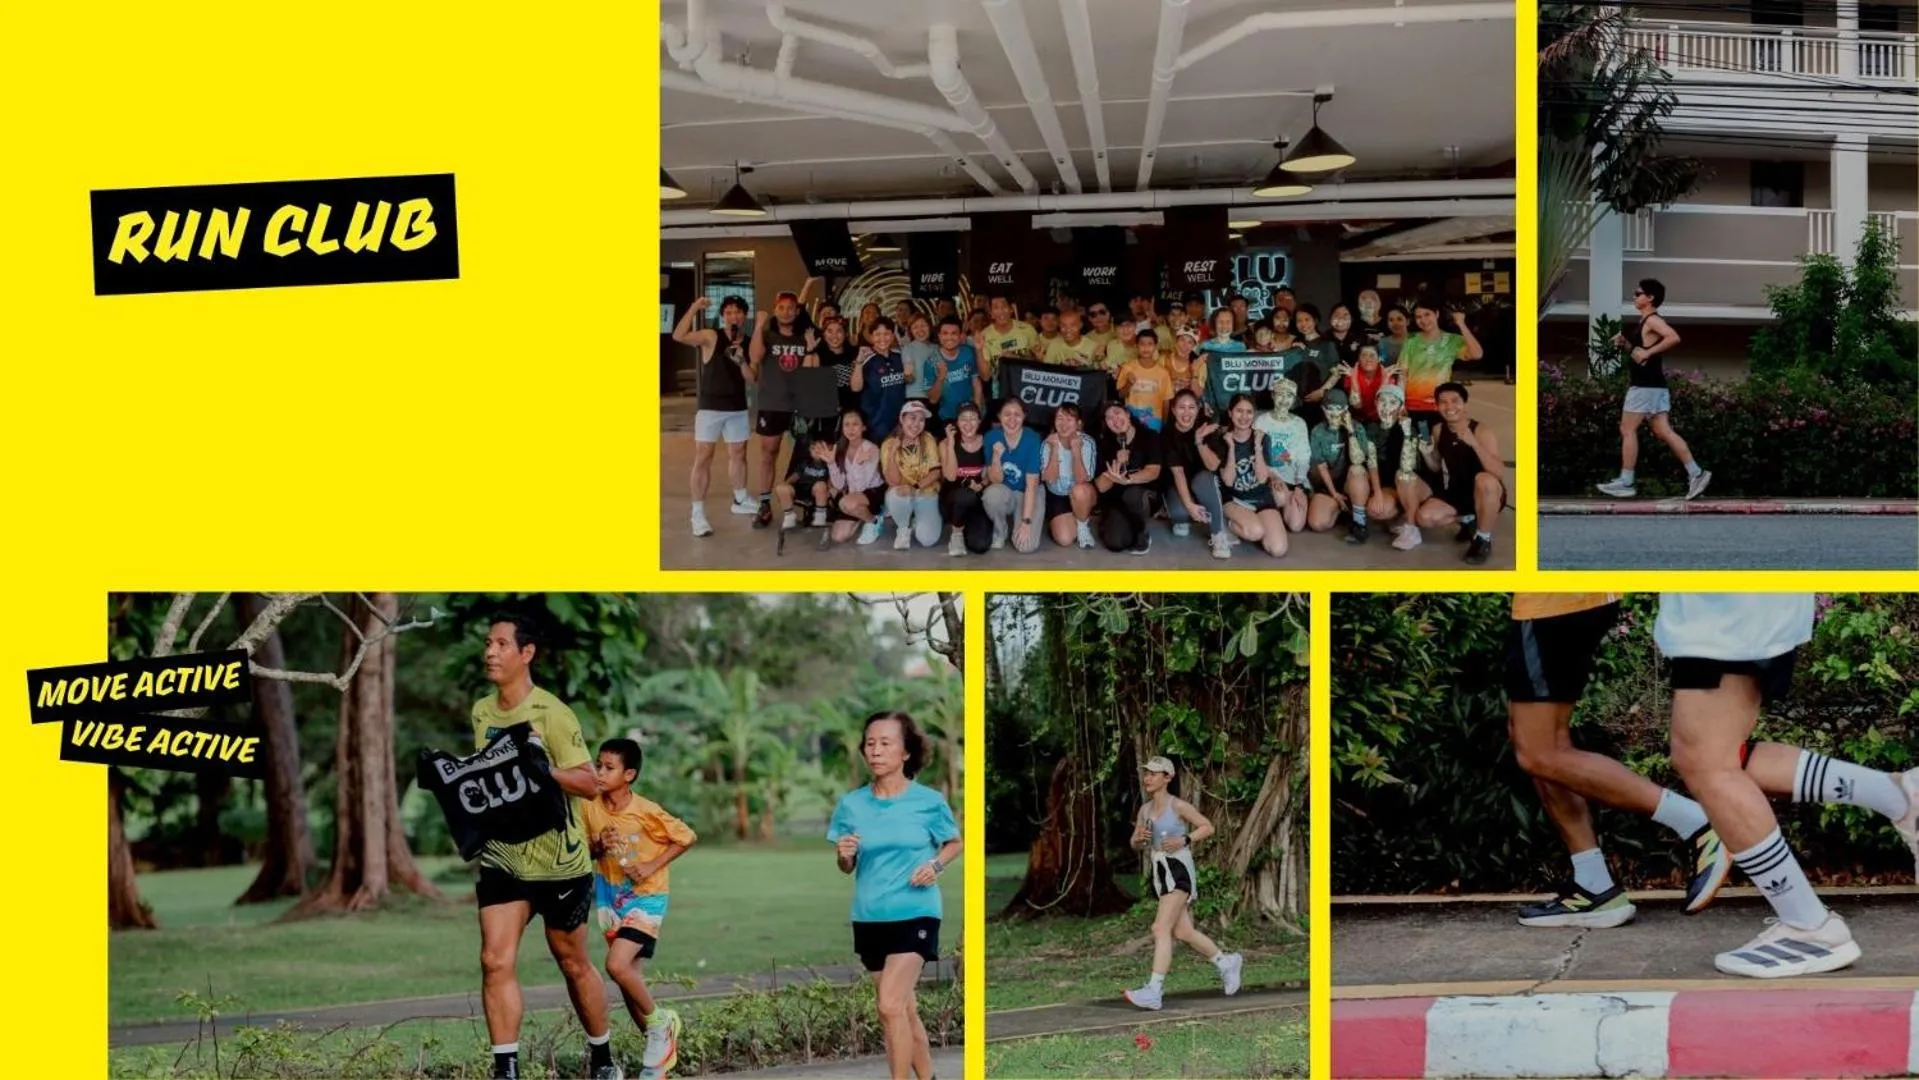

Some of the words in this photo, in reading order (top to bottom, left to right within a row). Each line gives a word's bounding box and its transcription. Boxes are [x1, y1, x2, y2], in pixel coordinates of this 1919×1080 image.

[815, 257, 848, 267] MOVE
[1183, 260, 1217, 273] REST
[989, 262, 1014, 274] EAT
[1083, 267, 1116, 277] WORK
[920, 272, 945, 284] VIBE
[988, 274, 1014, 284] WELL
[1088, 277, 1111, 285] WELL
[1186, 273, 1216, 283] WELL
[1224, 359, 1242, 368] BLU
[1244, 358, 1282, 368] MONKEY
[1042, 373, 1079, 387] MONKEY
[458, 764, 541, 814] CLU
